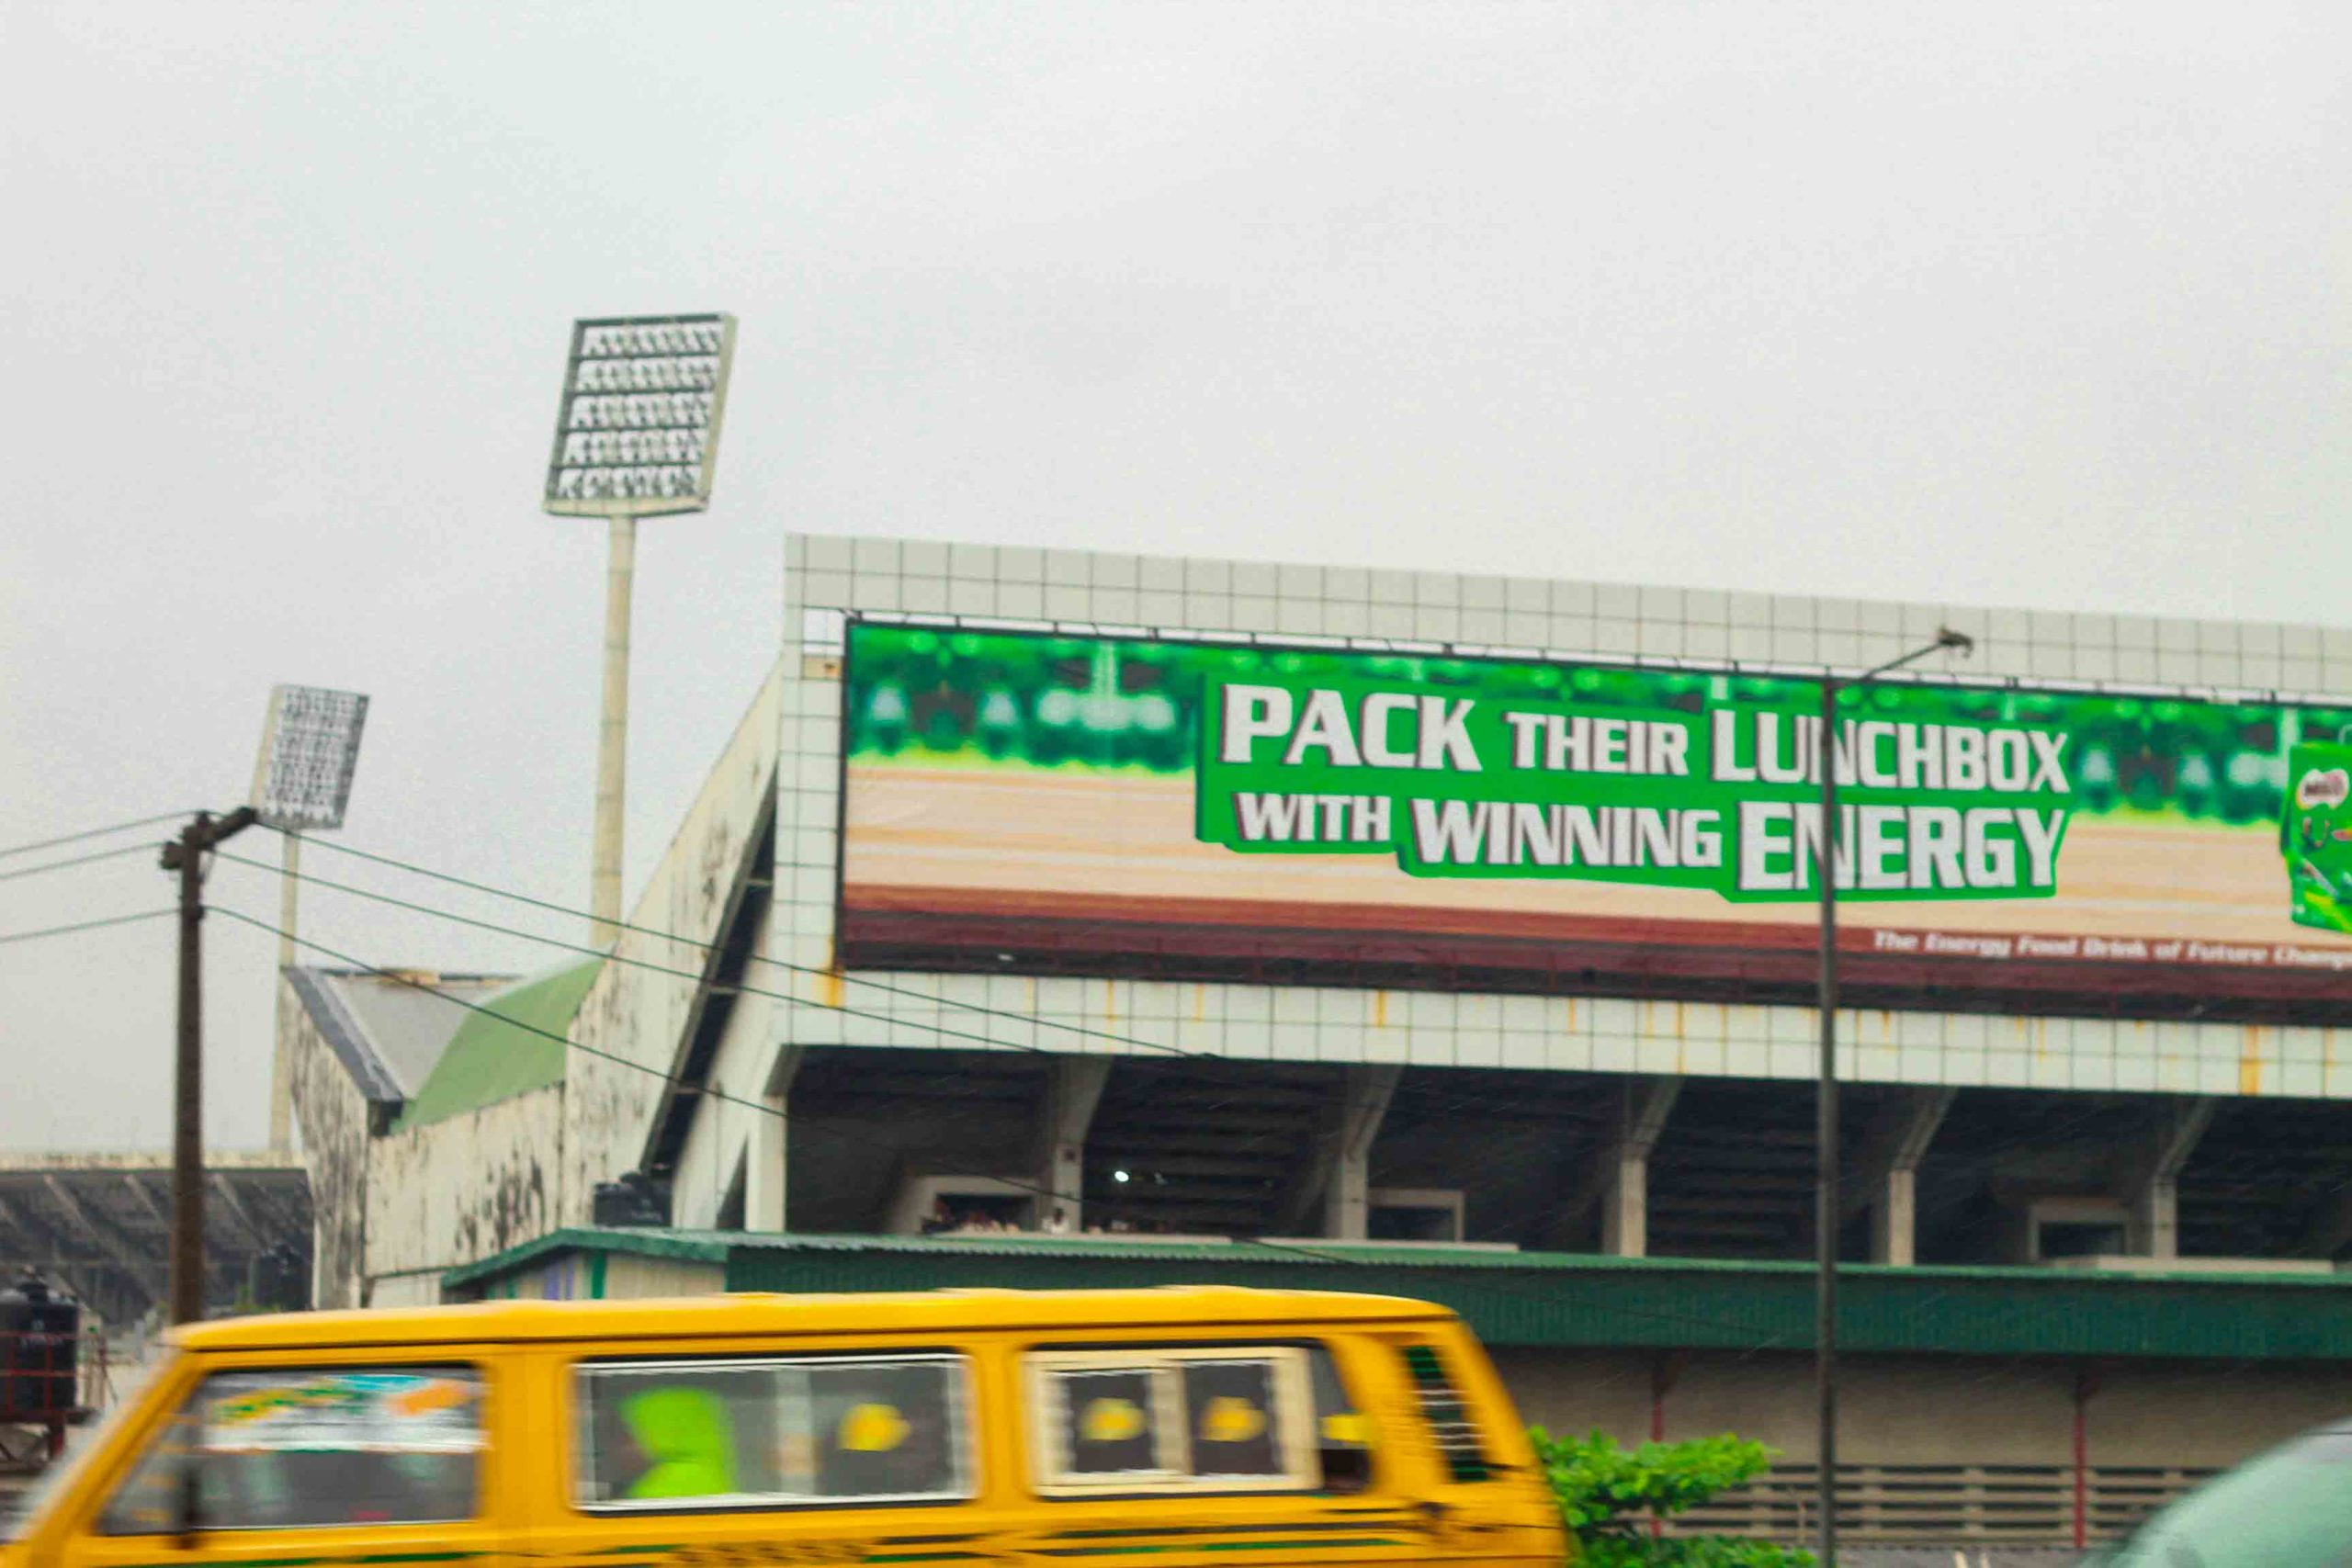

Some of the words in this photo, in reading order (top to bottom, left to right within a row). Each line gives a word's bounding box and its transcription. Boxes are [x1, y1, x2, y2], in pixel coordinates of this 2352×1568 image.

[1219, 683, 1482, 772] PACK
[1504, 711, 1689, 775] THEIR
[1711, 709, 2070, 794] LUNCHBOX
[1234, 793, 1391, 841] WITH
[1410, 798, 1722, 867] WINNING
[1738, 800, 2064, 891] ENERGY
[1873, 928, 1918, 950] The
[1924, 932, 2012, 958] Energy
[2018, 935, 2078, 956] Food
[2082, 937, 2147, 961] Drink
[2154, 941, 2181, 963] of
[2188, 941, 2267, 964] Future
